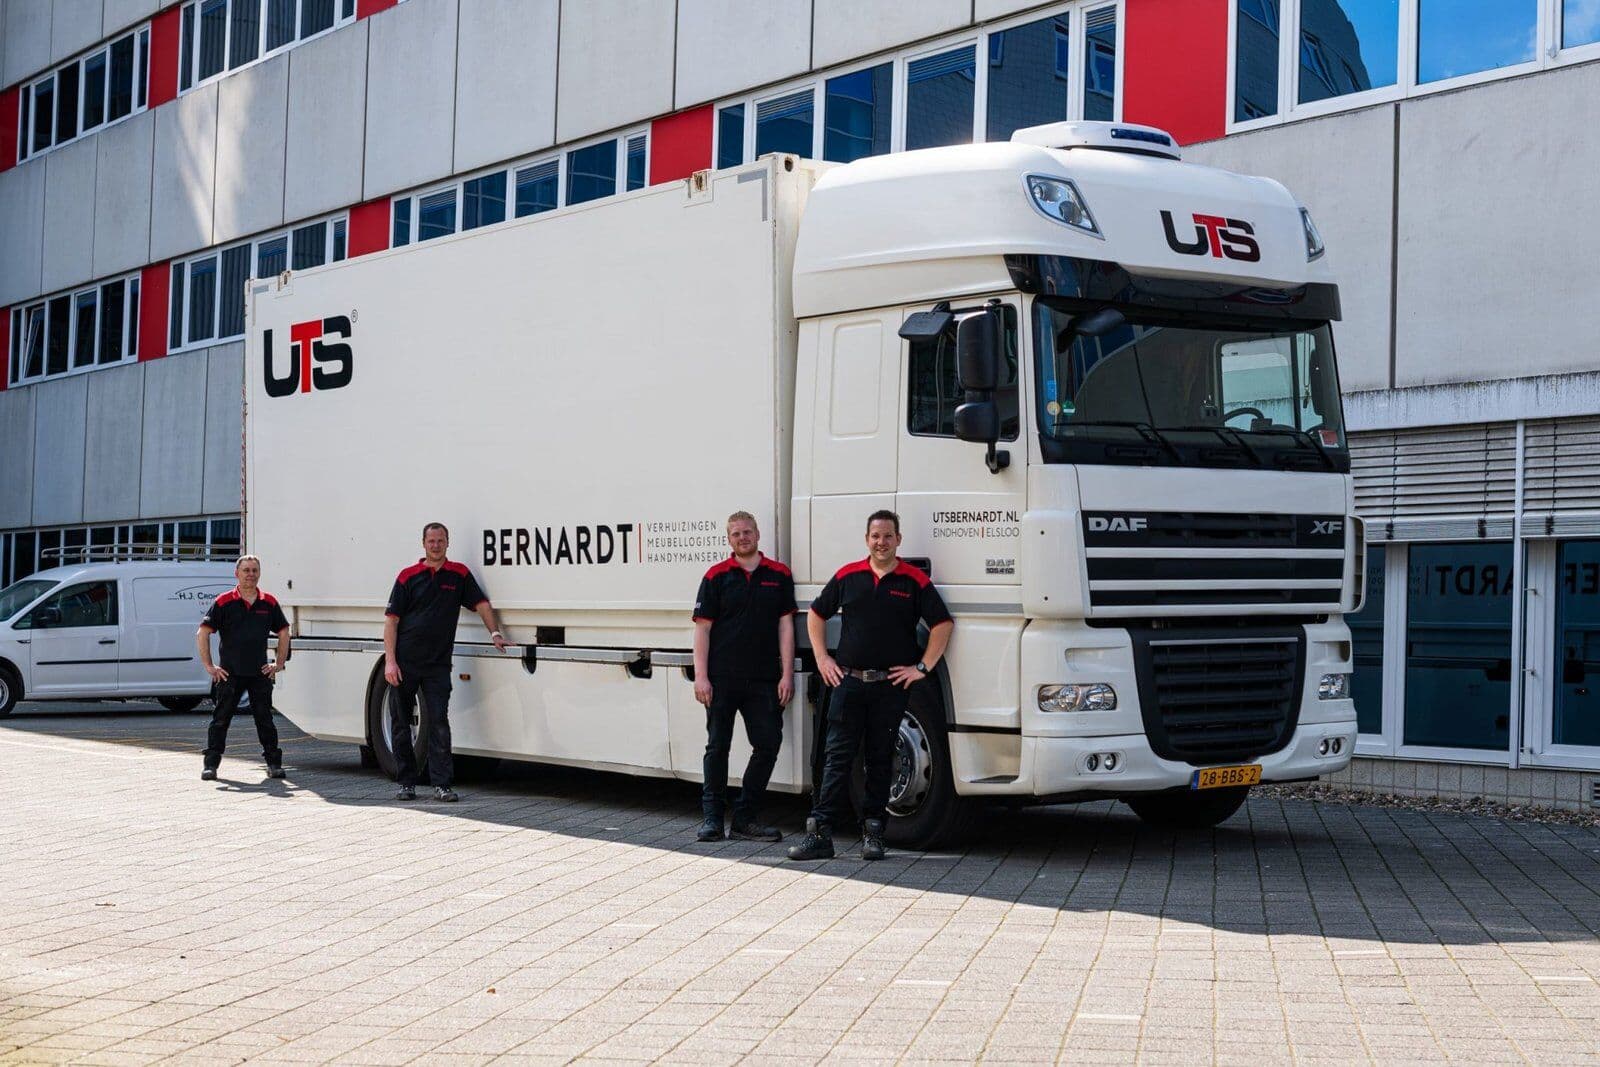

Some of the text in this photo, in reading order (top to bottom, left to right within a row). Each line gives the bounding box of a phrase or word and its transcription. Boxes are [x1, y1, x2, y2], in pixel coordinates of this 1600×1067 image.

[1160, 210, 1261, 262] UTS
[263, 315, 353, 398] UTS
[933, 510, 1020, 523] UTSBERNARDT.NL
[647, 520, 717, 533] VERHUIZINGEN
[1088, 517, 1148, 532] DAF
[1310, 520, 1342, 535] XF
[933, 527, 1020, 538] EINDHOVEN ELSLOO
[483, 523, 633, 566] BERNARDT
[647, 535, 730, 548] MEUBELLOGISTIE
[647, 551, 728, 563] HANDYMANSERVI
[1202, 768, 1257, 787] 28-BBS-2
